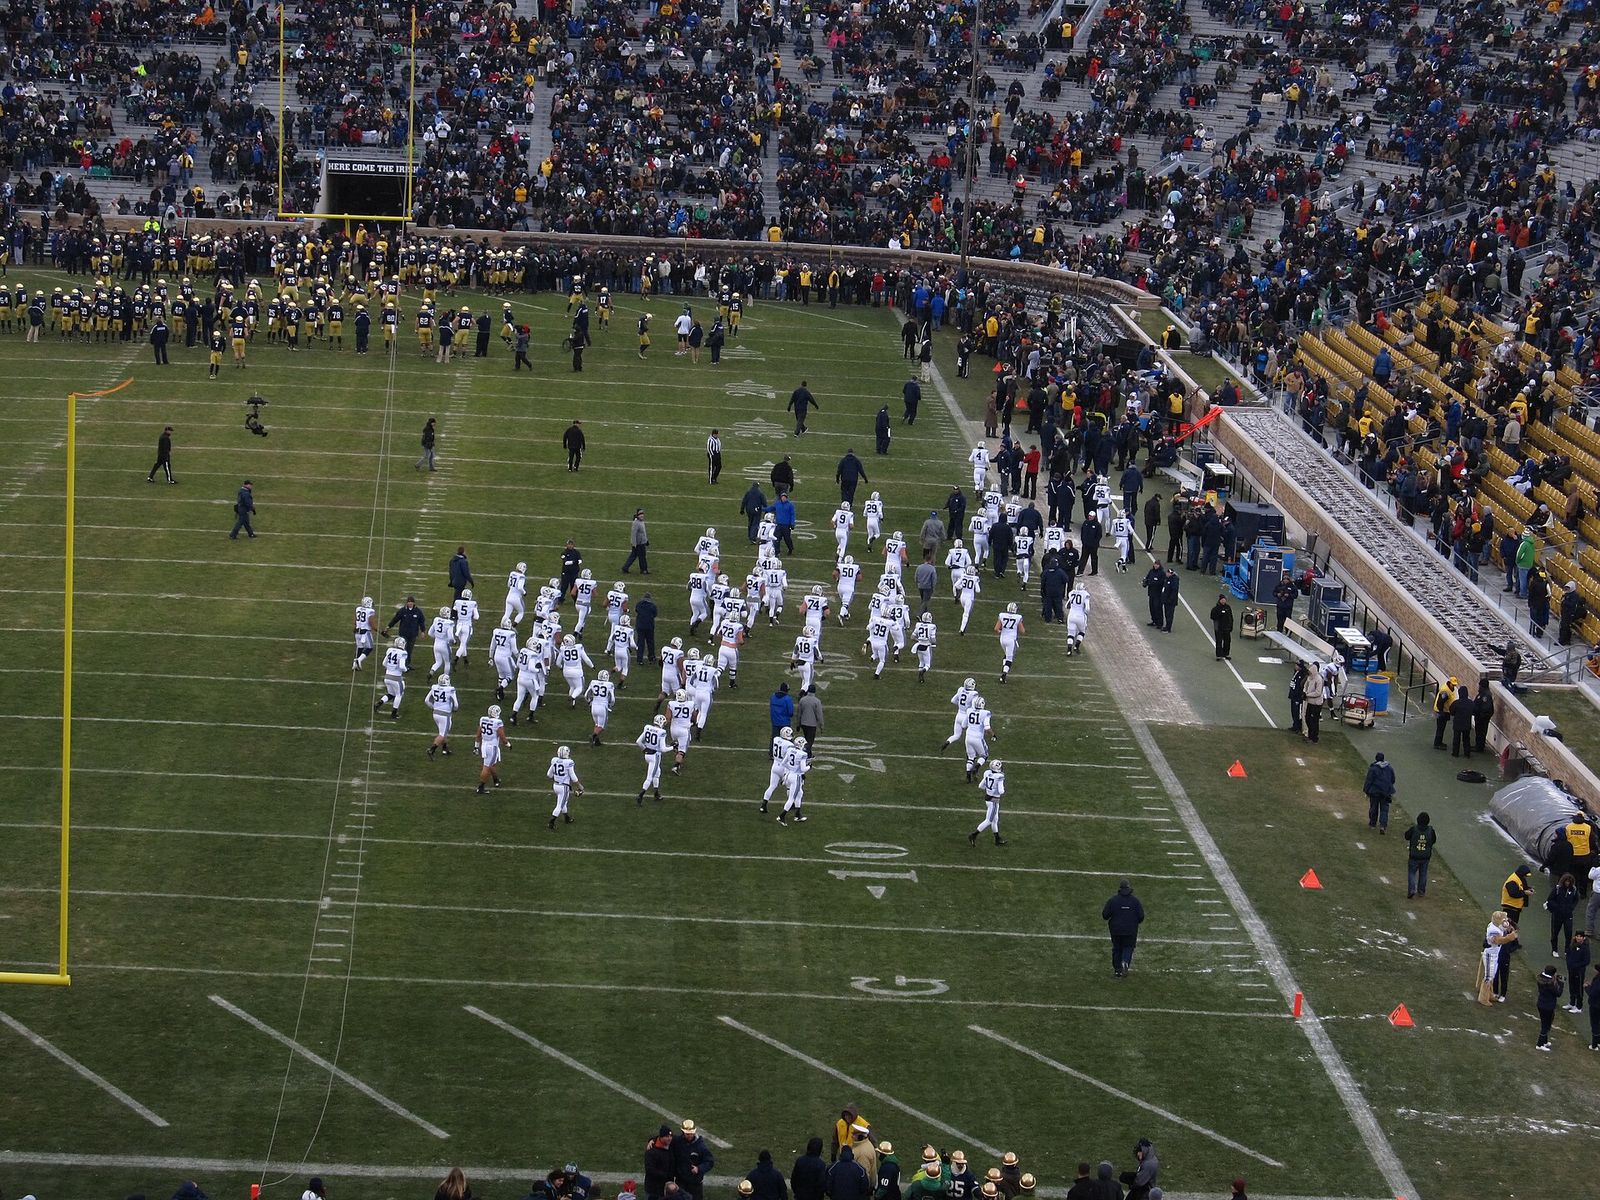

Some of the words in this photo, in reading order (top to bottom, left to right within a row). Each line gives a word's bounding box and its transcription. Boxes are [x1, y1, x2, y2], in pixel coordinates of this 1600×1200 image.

[328, 162, 351, 171] HERE
[352, 163, 375, 172] COME
[377, 164, 394, 173] THE
[395, 165, 419, 174] IRH
[600, 296, 607, 304] 17
[332, 311, 341, 319] 78
[461, 318, 471, 326] 67
[233, 327, 243, 336] 27
[976, 453, 982, 461] 4
[987, 495, 999, 505] 20
[866, 503, 878, 514] 29
[1007, 507, 1016, 517] 21
[839, 514, 846, 524] 9
[761, 526, 767, 536] 7
[973, 520, 982, 531] 10
[1115, 522, 1125, 532] 15
[1048, 530, 1061, 540] 23
[887, 543, 898, 554] 67
[1017, 539, 1028, 550] 13
[955, 552, 962, 563] 7
[770, 573, 779, 584] 11
[842, 567, 854, 578] 50
[578, 583, 591, 594] 45
[747, 579, 759, 591] 24
[962, 579, 974, 590] 30
[609, 595, 622, 607] 25
[808, 599, 820, 611] 74
[1070, 594, 1082, 605] 70
[460, 605, 468, 616] 5
[726, 602, 740, 613] 95
[356, 610, 367, 622] 39
[436, 622, 444, 633] 3
[1002, 618, 1016, 629] 77
[614, 630, 627, 643] 23
[722, 625, 735, 638] 72
[873, 624, 887, 637] 39
[918, 627, 929, 639] 21
[494, 634, 507, 647] 57
[798, 642, 810, 654] 18
[387, 652, 398, 665] 44
[564, 649, 579, 661] 99
[662, 651, 674, 665] 73
[698, 670, 708, 682] 11
[433, 690, 447, 702] 54
[593, 685, 608, 697] 33
[960, 693, 967, 706] 2
[674, 706, 690, 719] 79
[968, 712, 980, 725] 61
[480, 722, 494, 735] 55
[644, 731, 658, 746] 80
[773, 743, 783, 759] 31
[789, 753, 796, 766] 3
[553, 763, 565, 776] 12
[985, 776, 995, 790] 17
[824, 841, 919, 884] 10
[850, 975, 950, 997] G
